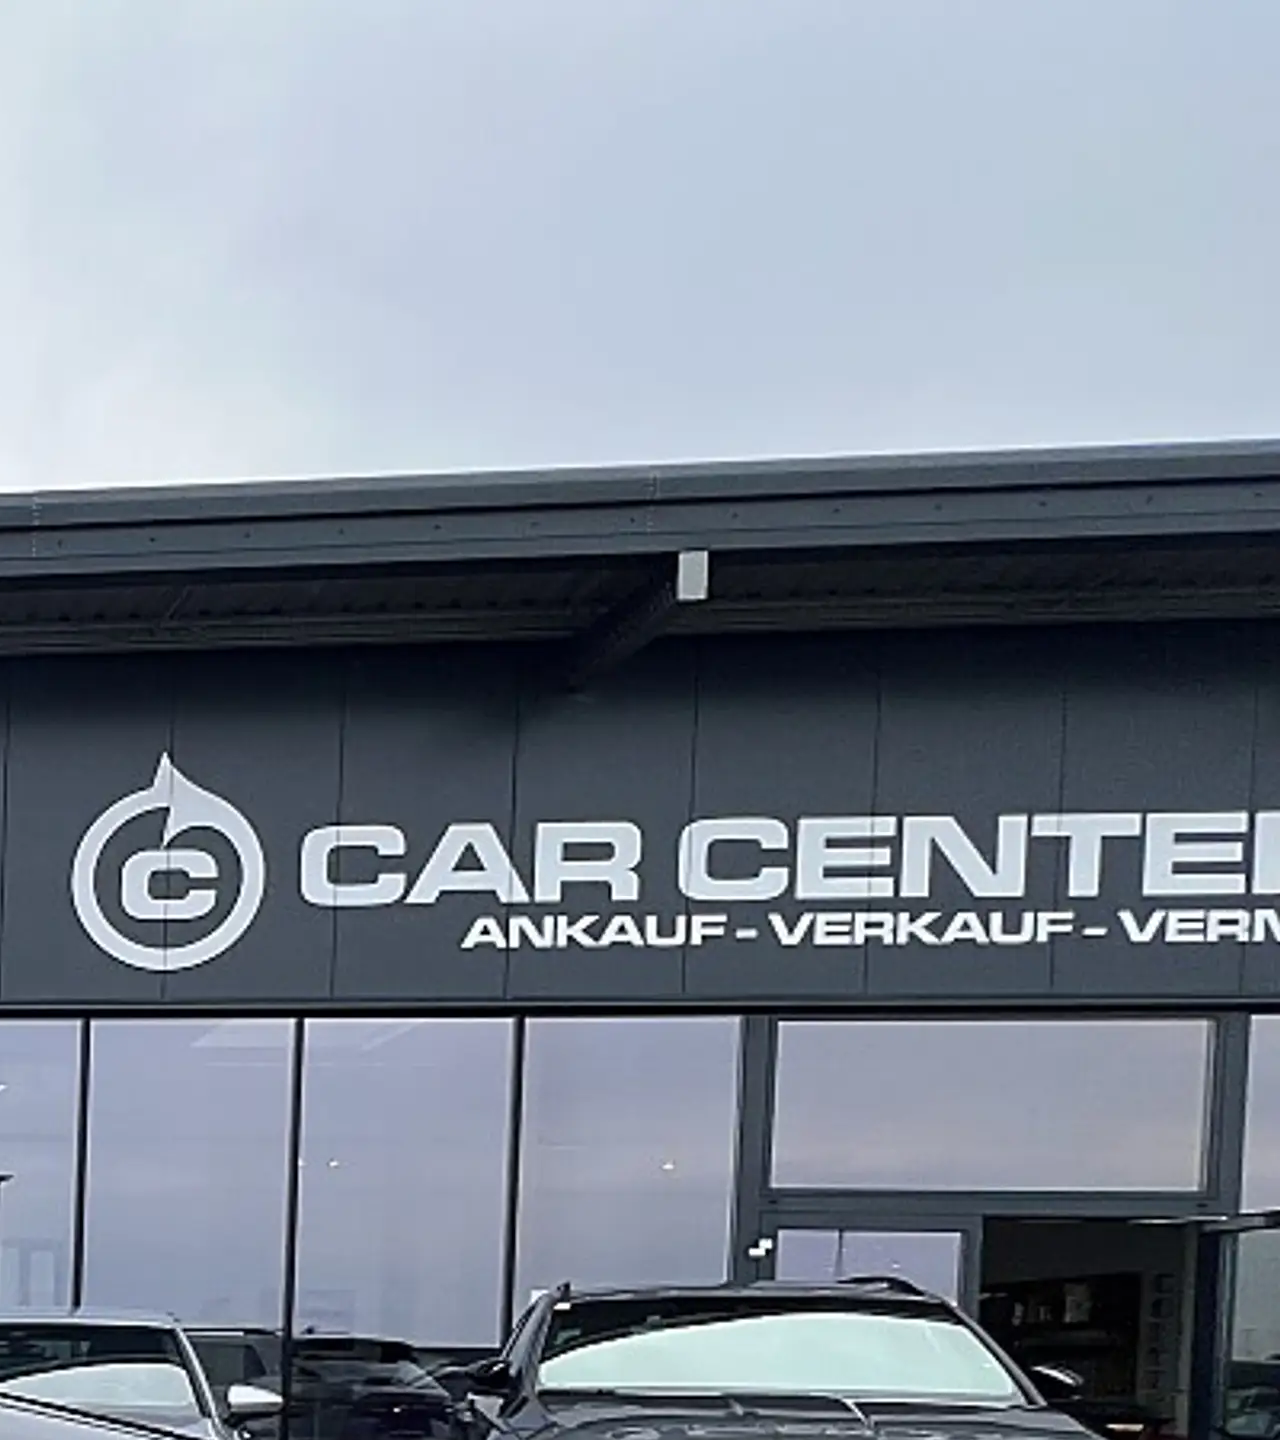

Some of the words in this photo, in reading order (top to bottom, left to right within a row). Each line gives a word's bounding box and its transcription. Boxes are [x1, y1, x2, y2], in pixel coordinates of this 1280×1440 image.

[301, 822, 641, 906] CAR
[679, 811, 1280, 900] CENTE
[461, 914, 727, 949] ANKAUF
[769, 911, 1074, 945] VERKAUF
